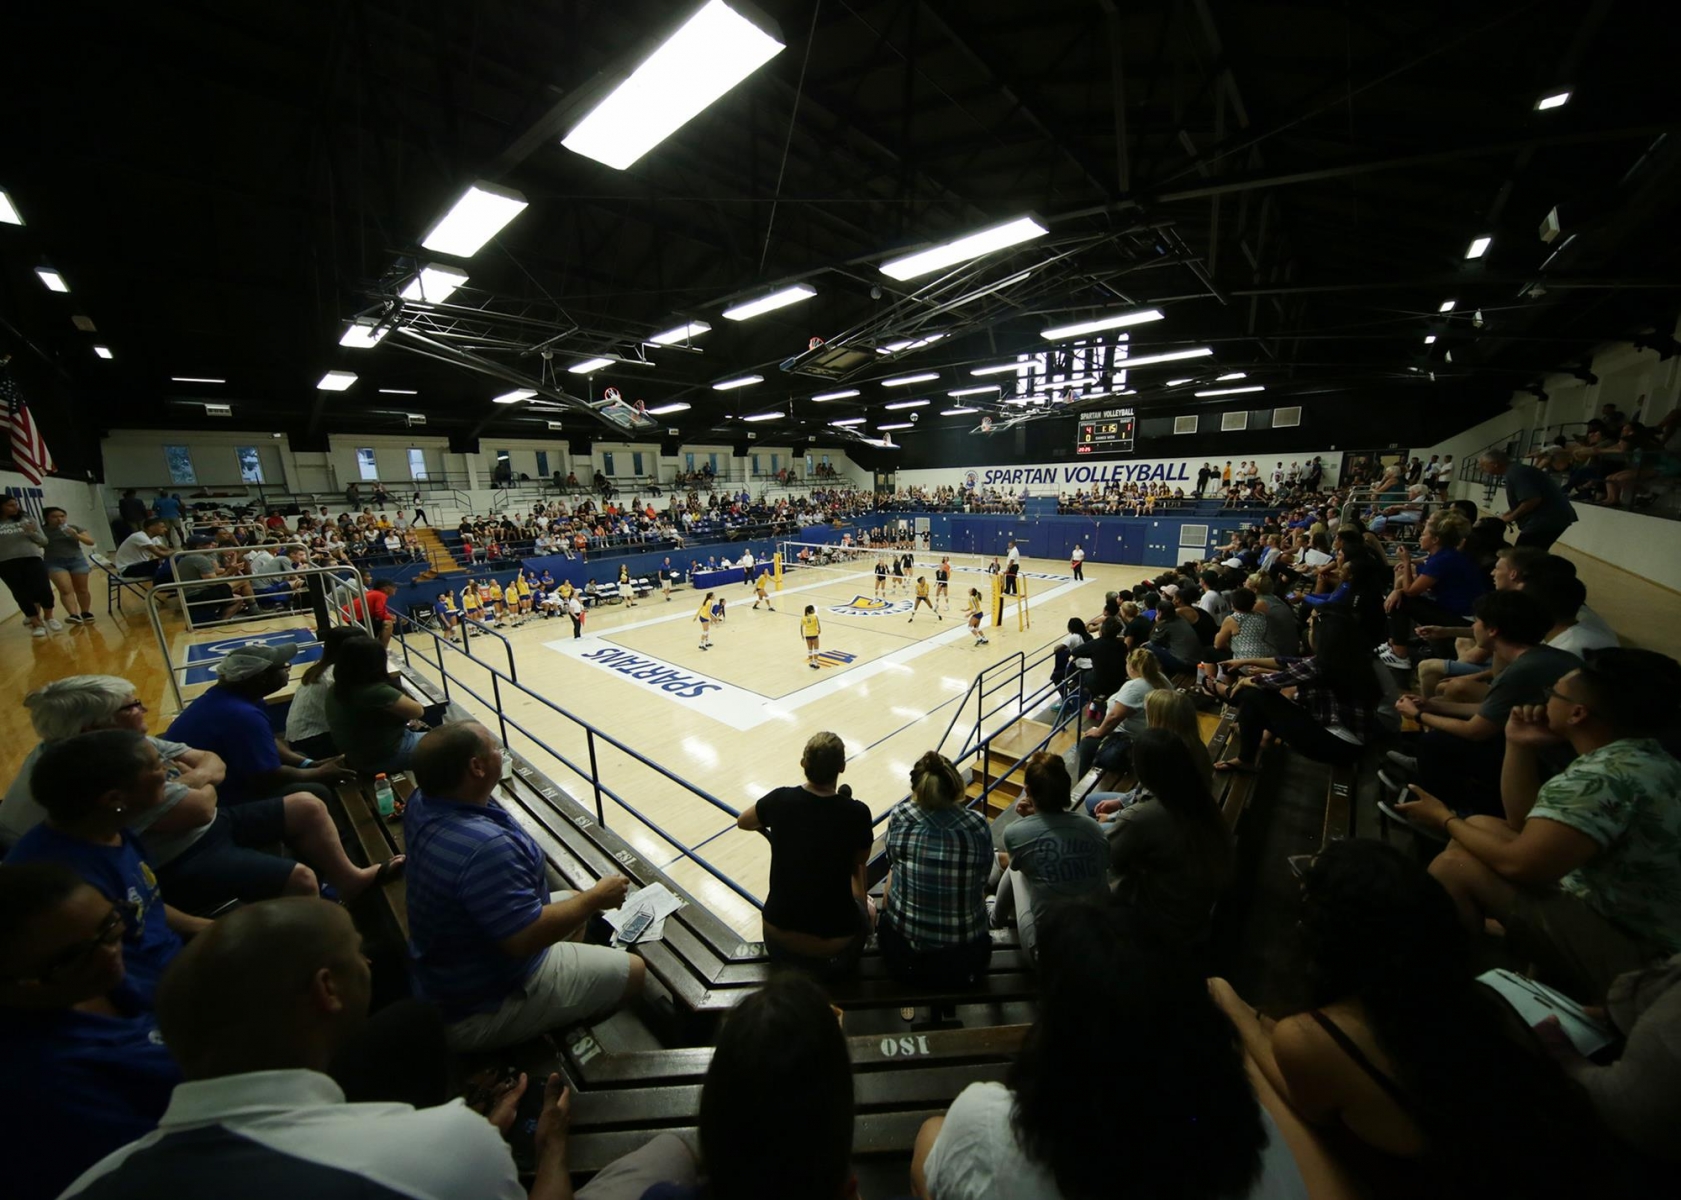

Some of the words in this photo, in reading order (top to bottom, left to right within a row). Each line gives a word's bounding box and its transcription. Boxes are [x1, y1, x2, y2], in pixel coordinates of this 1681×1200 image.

[1080, 411, 1101, 420] SPARTAN
[1103, 408, 1134, 418] VOLLEYBALL
[984, 468, 1058, 484] SPARTAN
[1064, 463, 1190, 483] VOLLEYBALL
[581, 648, 722, 698] SPARTANS
